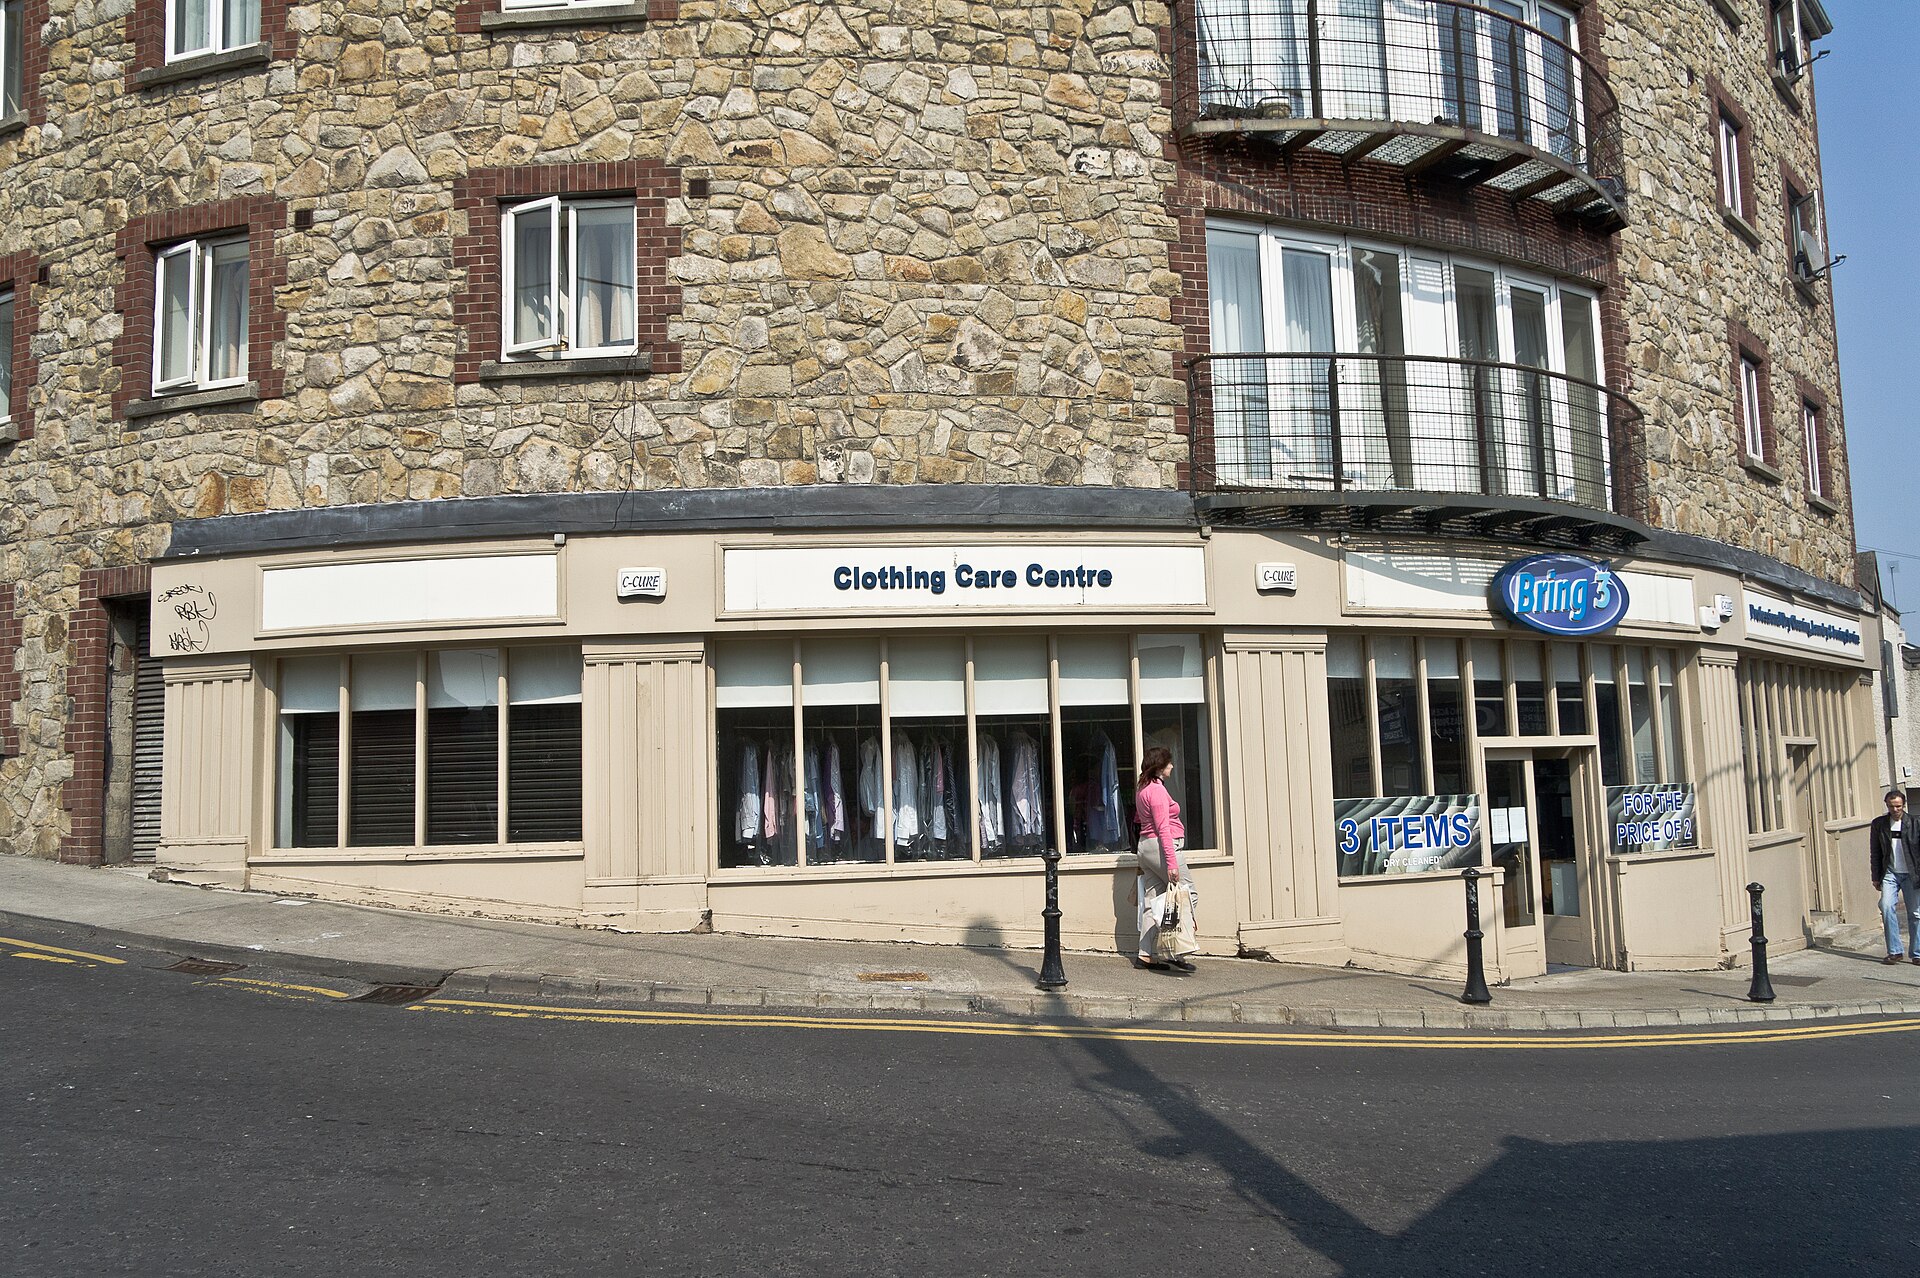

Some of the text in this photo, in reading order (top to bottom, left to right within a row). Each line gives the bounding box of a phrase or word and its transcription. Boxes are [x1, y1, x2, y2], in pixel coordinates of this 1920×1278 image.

[622, 575, 660, 588] C-CURE
[834, 562, 1113, 595] Clothing Care Centre
[1264, 570, 1295, 582] C-CURE
[1514, 569, 1611, 622] Bring 3
[1623, 791, 1683, 816] FOR THE
[1339, 818, 1361, 855] 3
[1370, 812, 1472, 853] ITEMS
[1616, 817, 1692, 845] PRICE OF 2
[1383, 858, 1401, 868] DRY
